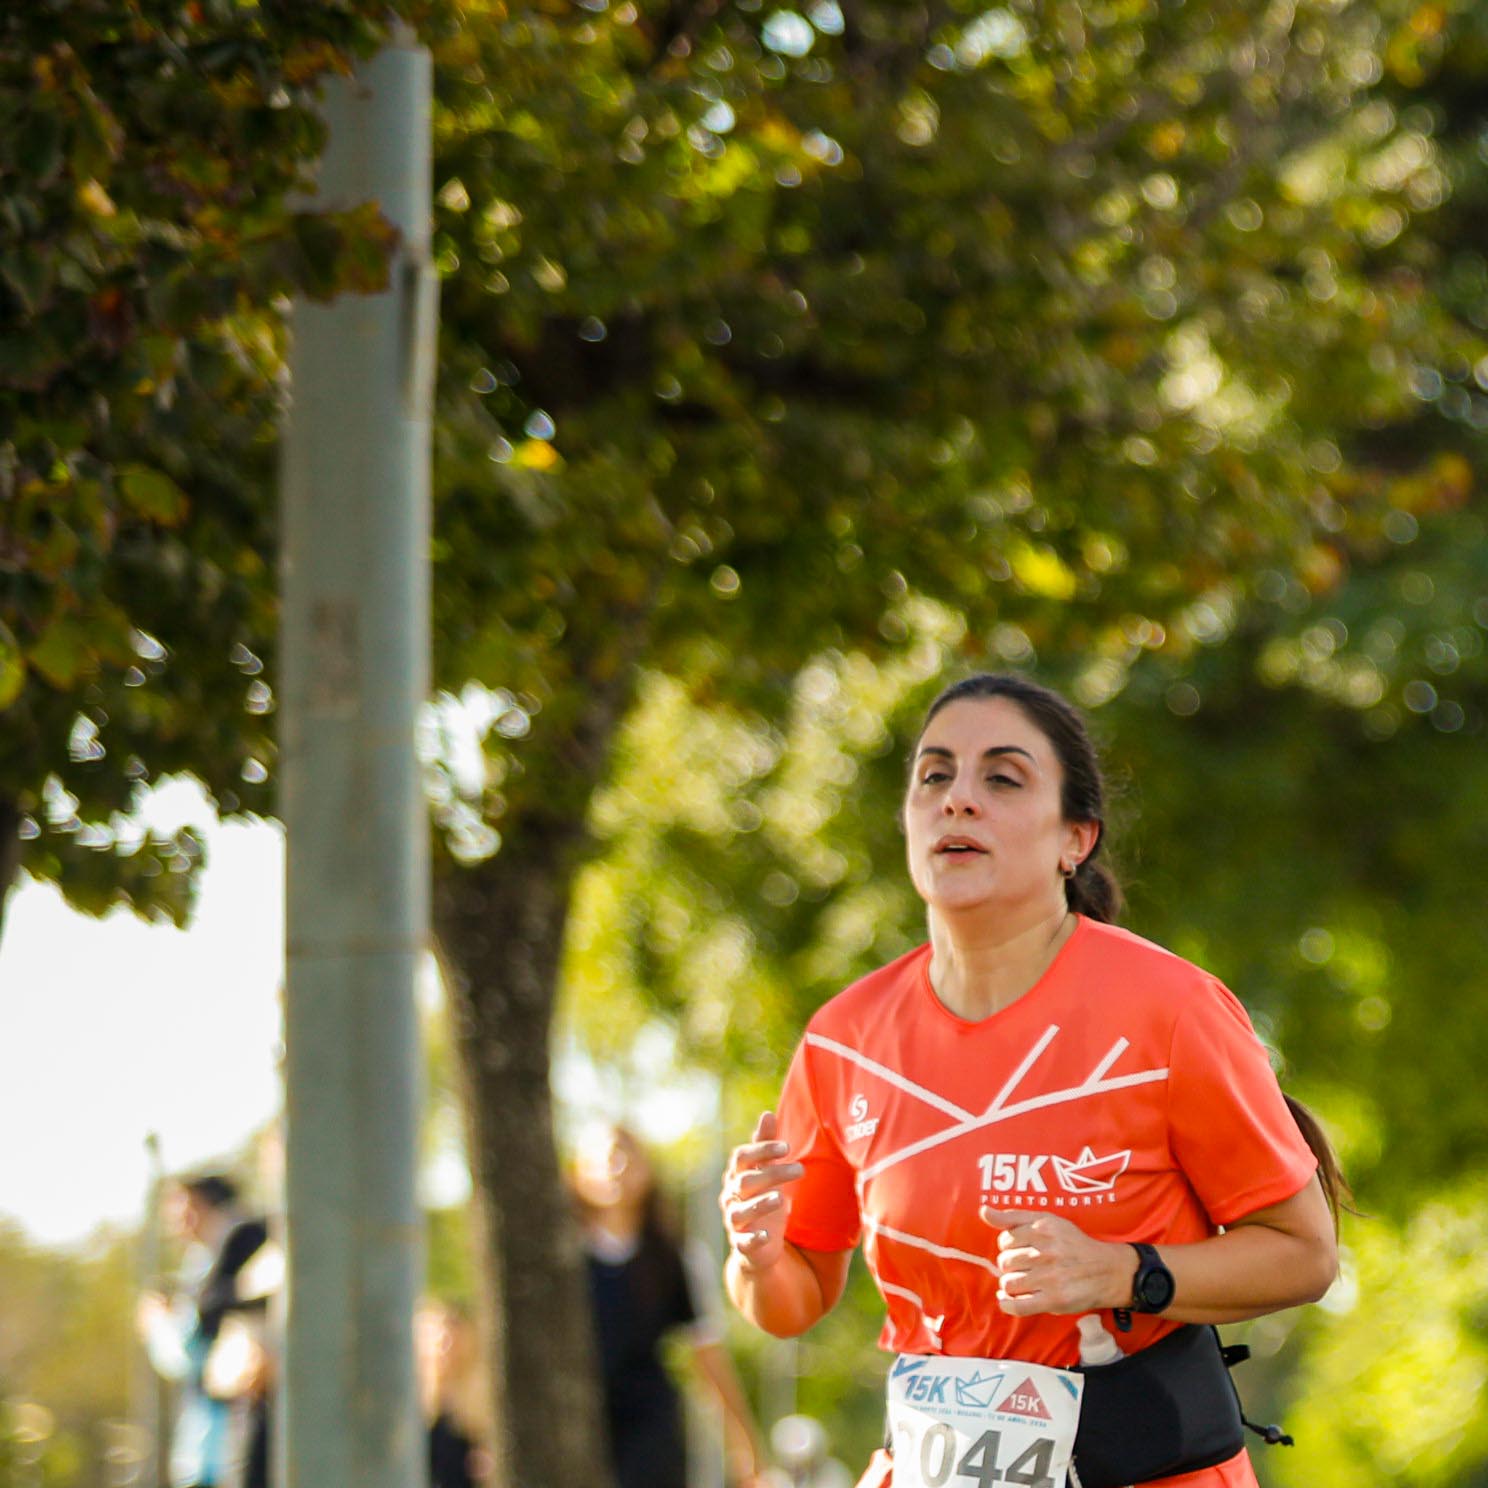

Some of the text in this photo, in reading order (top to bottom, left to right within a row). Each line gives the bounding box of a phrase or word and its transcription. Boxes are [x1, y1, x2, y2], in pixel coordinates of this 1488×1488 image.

[978, 1153, 1049, 1193] 15K
[981, 1192, 1116, 1206] PUERTO NORTE
[905, 1375, 950, 1404] 15K
[1009, 1393, 1041, 1413] 15K
